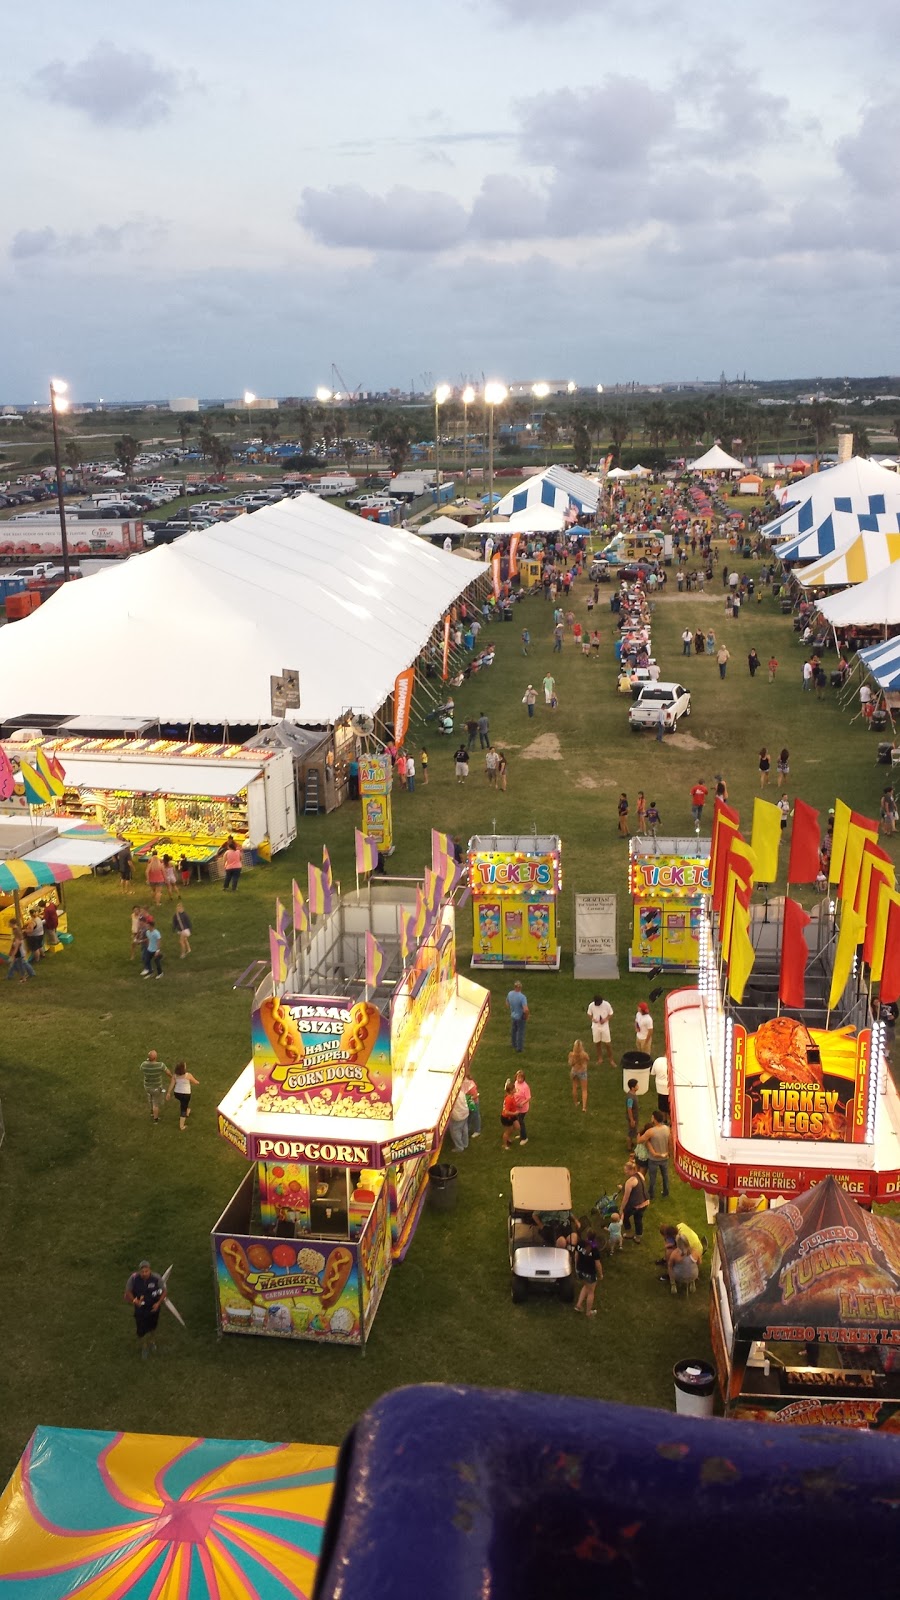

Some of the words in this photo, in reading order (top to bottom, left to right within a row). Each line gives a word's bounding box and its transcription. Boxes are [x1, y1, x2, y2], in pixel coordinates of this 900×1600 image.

[361, 769, 385, 781] ATM
[477, 862, 551, 884] TICKETS
[641, 864, 712, 887] TICKETS
[289, 1005, 353, 1024] TEXAS
[297, 1019, 345, 1035] SIZE
[304, 1039, 340, 1056] HAND
[302, 1051, 351, 1068] DIPPED
[288, 1071, 324, 1088] CORN
[327, 1065, 363, 1082] DOGS
[734, 1037, 743, 1120] FRIES
[856, 1042, 867, 1126] FRIES
[779, 1082, 820, 1091] SMOKED
[760, 1090, 839, 1113] TURKEY
[773, 1111, 824, 1133] LEGS
[258, 1140, 370, 1164] POPCORN
[391, 1142, 426, 1161] DRINKS
[678, 1155, 719, 1185] DRINKS
[691, 1160, 708, 1171] COLD
[737, 1176, 771, 1188] FRENCH
[772, 1178, 797, 1190] FRIES
[809, 1180, 865, 1193] SAGE
[798, 1226, 859, 1255] JUMBO
[260, 1275, 316, 1289] WAGNER'S
[779, 1242, 876, 1305] TURKEY
[265, 1288, 300, 1299] CARNIVAL
[763, 1325, 816, 1342] JUMBO
[816, 1327, 880, 1344] TURKEY
[775, 1398, 821, 1421] JUMBO
